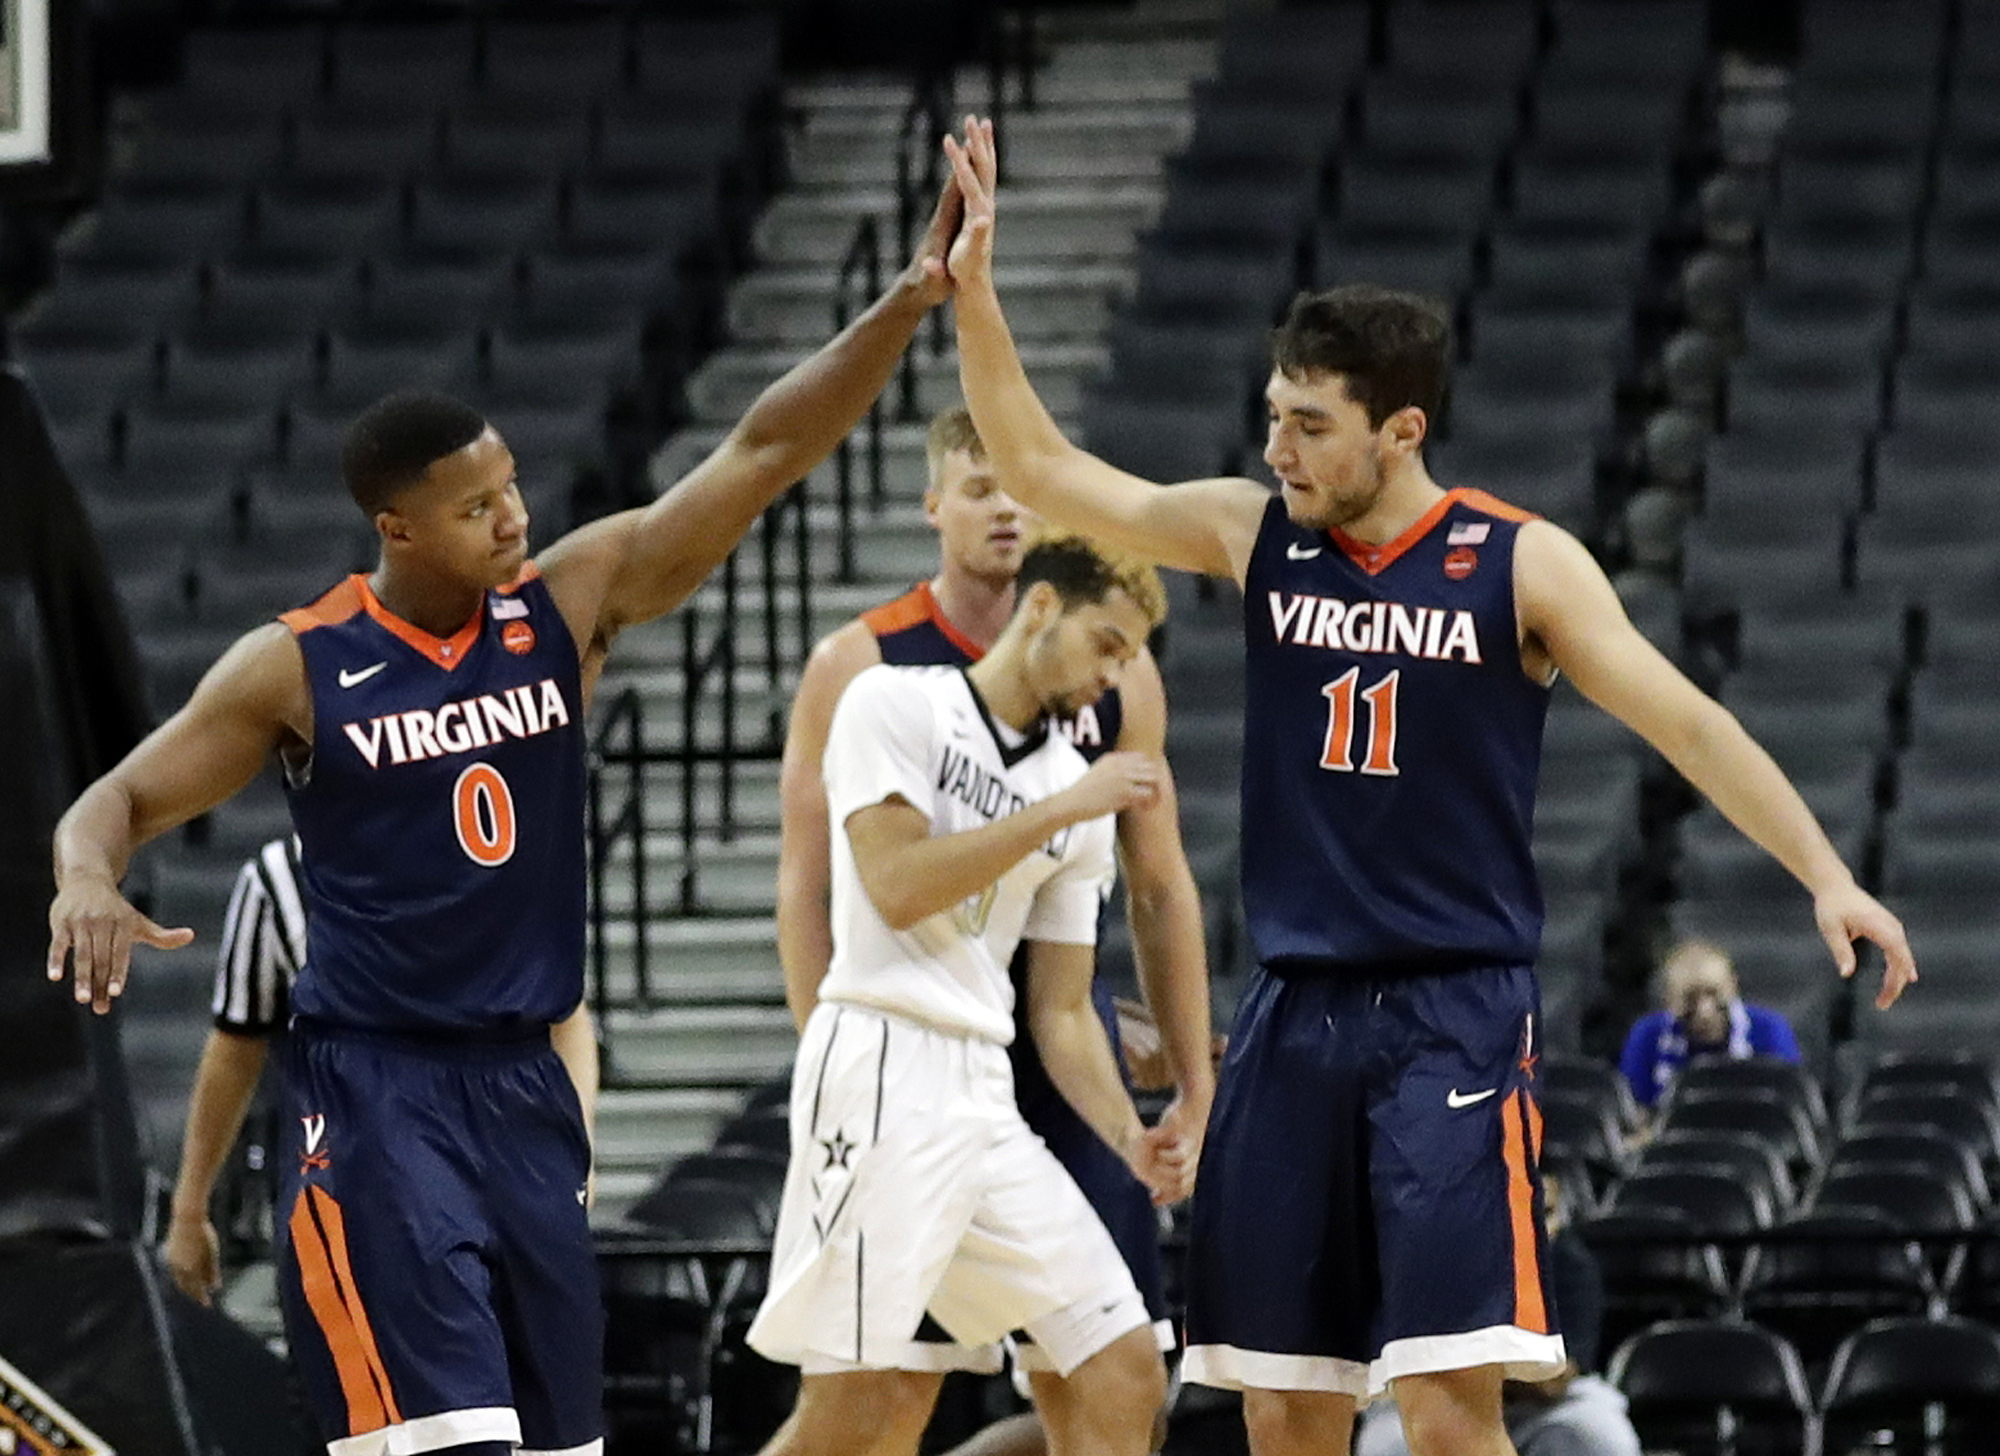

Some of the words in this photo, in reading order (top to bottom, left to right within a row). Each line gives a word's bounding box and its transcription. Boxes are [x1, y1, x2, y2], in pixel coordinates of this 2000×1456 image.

[1268, 592, 1482, 664] VIRGINIA
[344, 679, 569, 769] VIRGINIA
[1320, 666, 1400, 775] 11
[452, 763, 516, 866] 0
